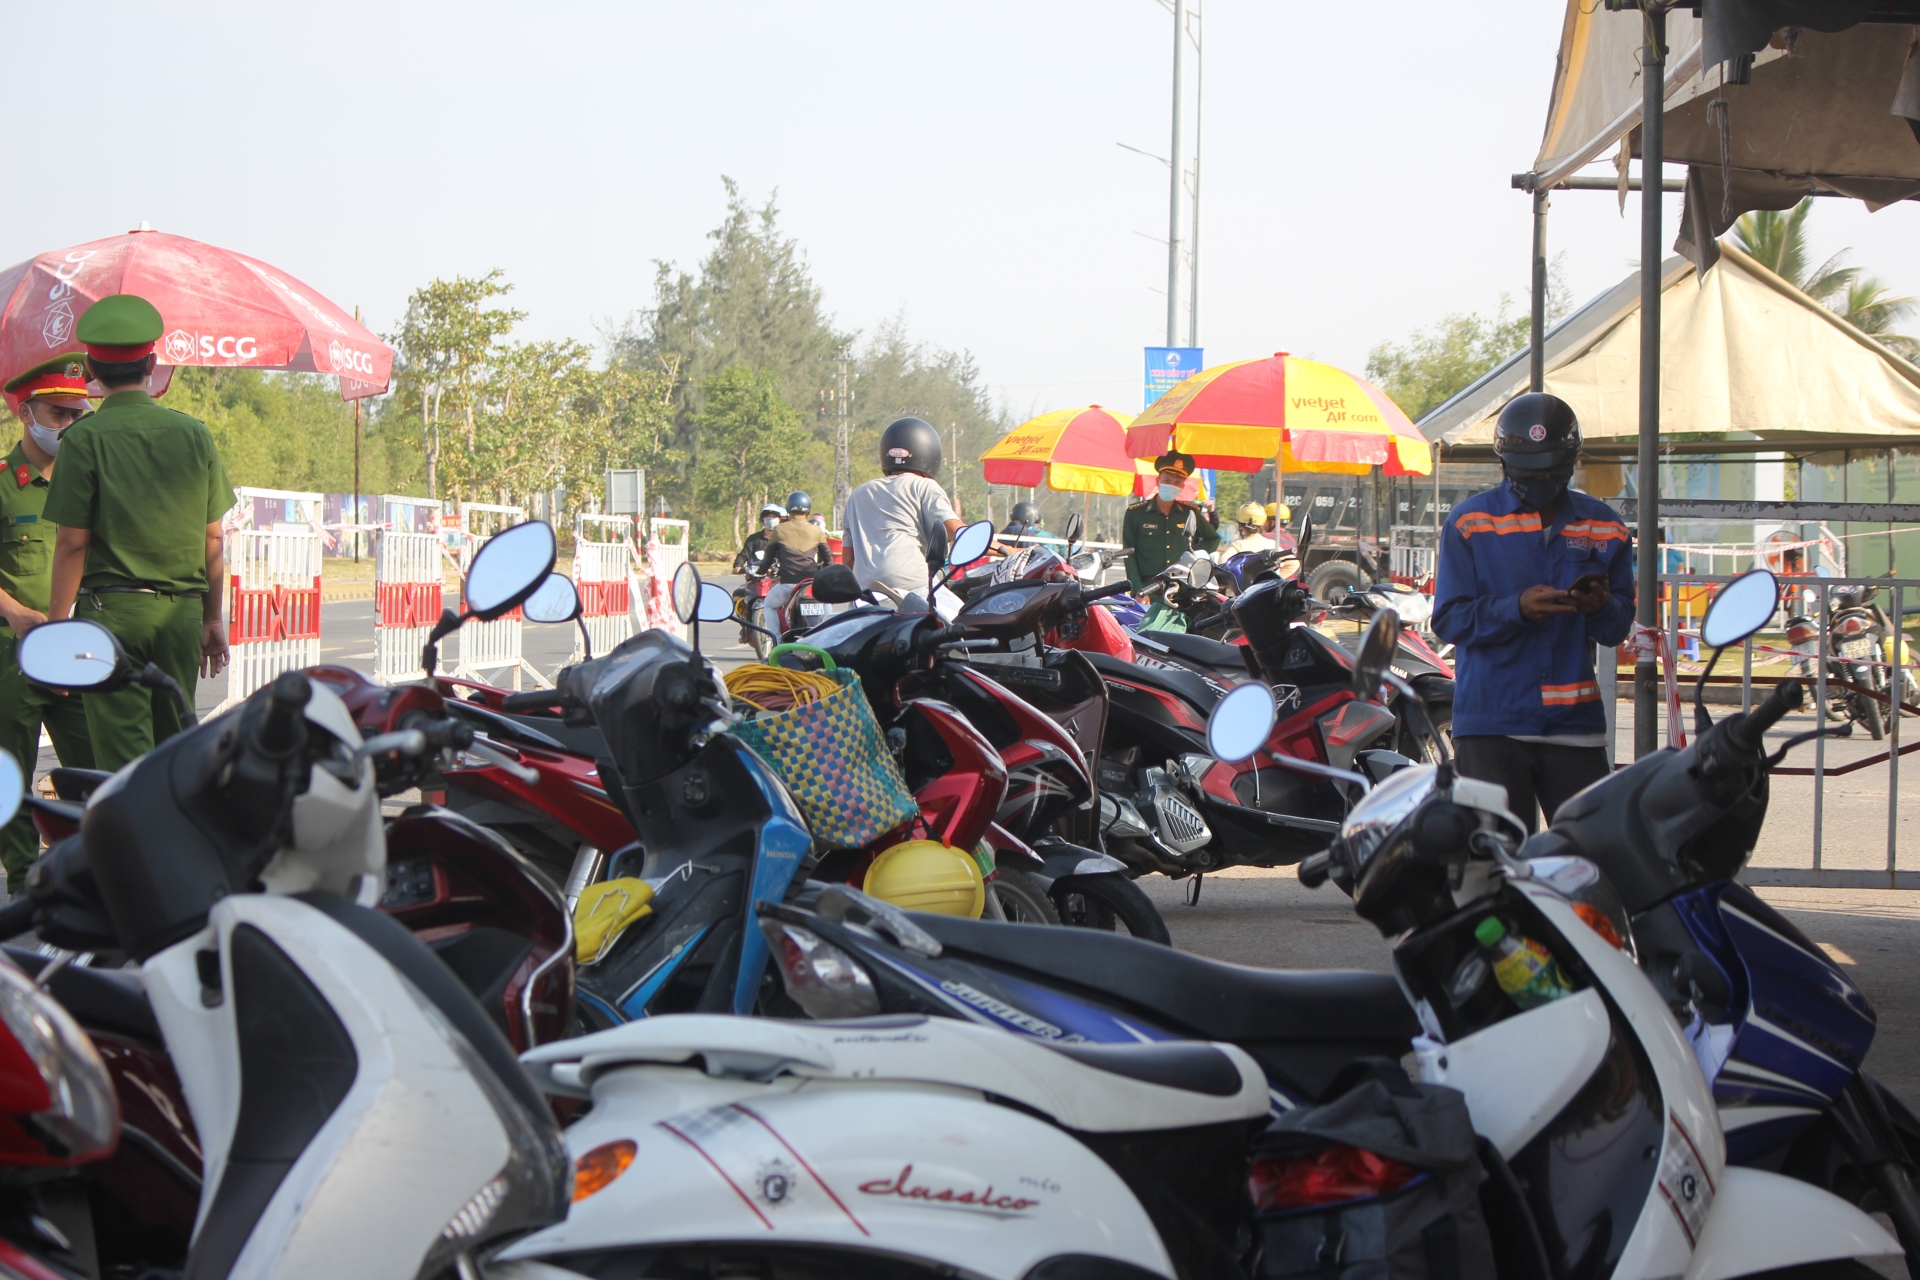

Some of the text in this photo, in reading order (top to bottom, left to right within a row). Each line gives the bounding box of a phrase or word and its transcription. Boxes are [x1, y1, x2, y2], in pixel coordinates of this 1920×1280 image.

[200, 336, 257, 358] SCG
[345, 348, 373, 375] SCG
[766, 850, 797, 860] HONDA
